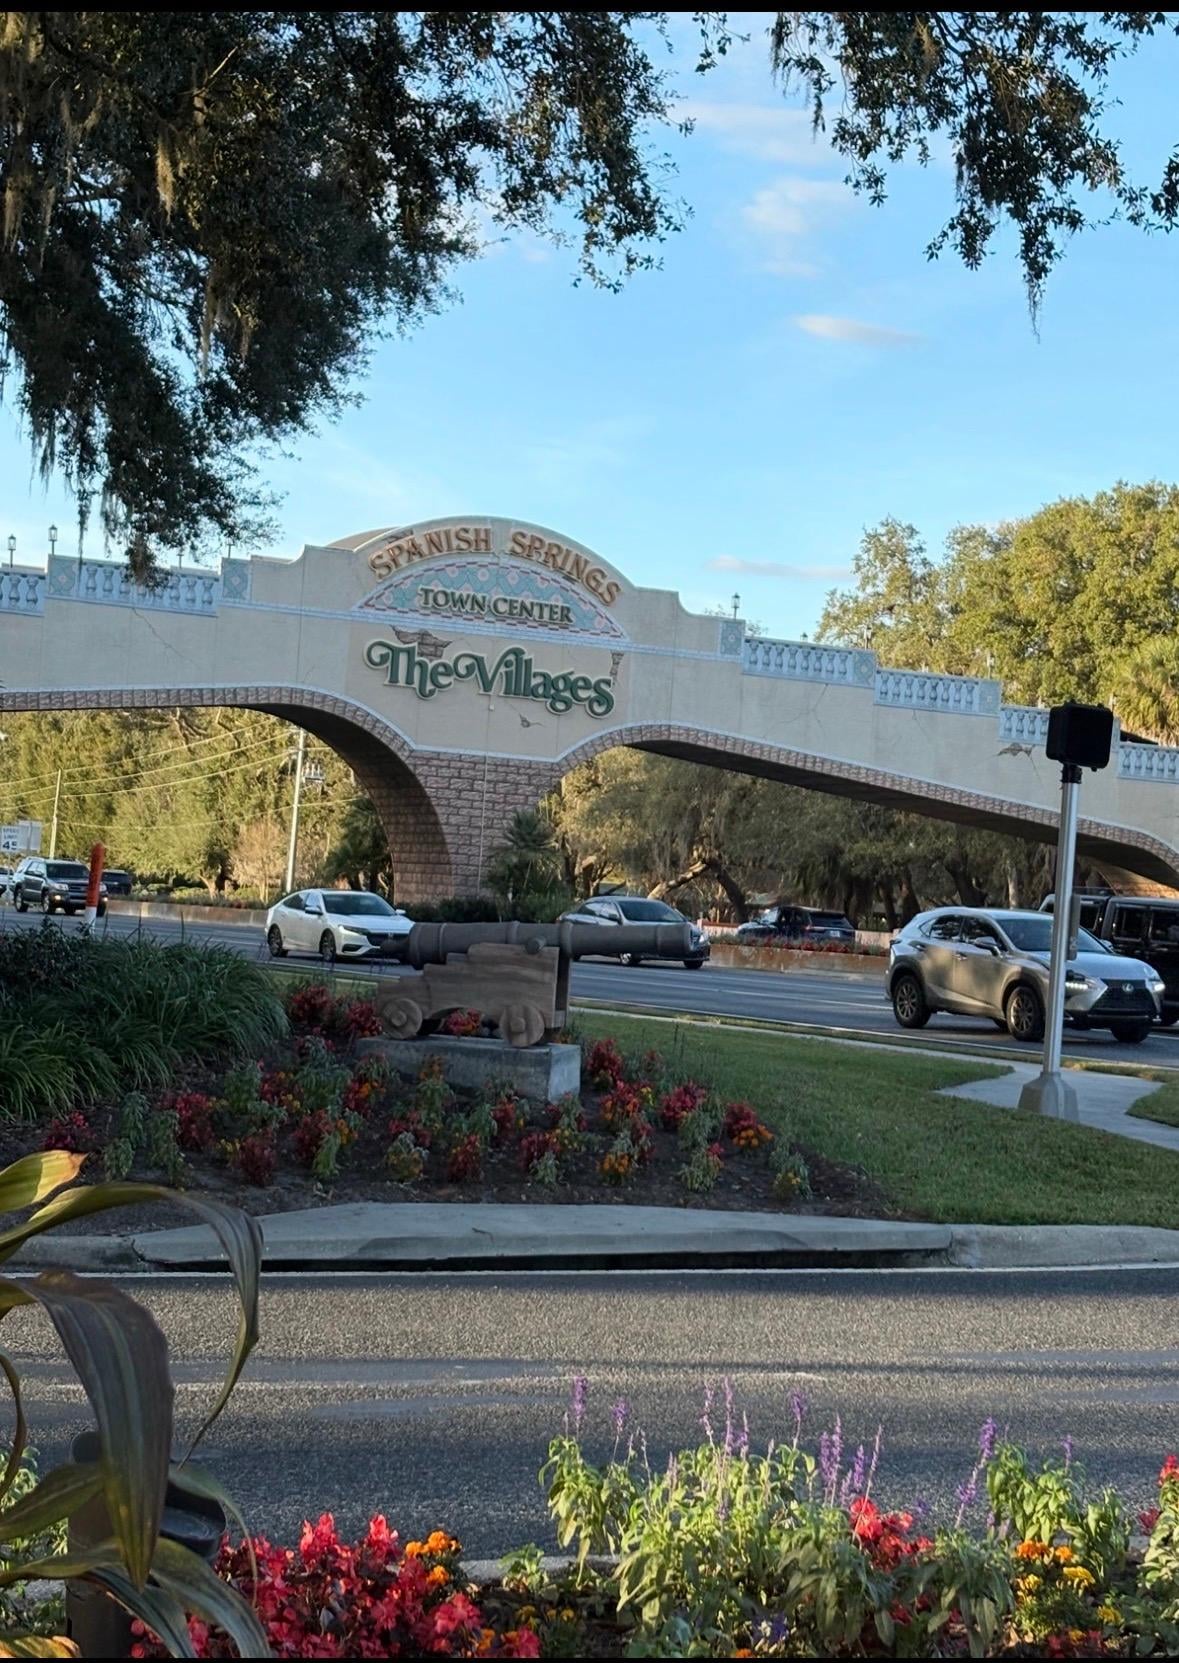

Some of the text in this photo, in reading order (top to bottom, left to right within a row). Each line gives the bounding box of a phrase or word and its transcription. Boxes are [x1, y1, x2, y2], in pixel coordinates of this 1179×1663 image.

[369, 528, 620, 604] SPANISH SPRINGS
[419, 588, 573, 623] TOWN CENTER
[366, 640, 614, 717] The Villages
[2, 840, 17, 850] 45
